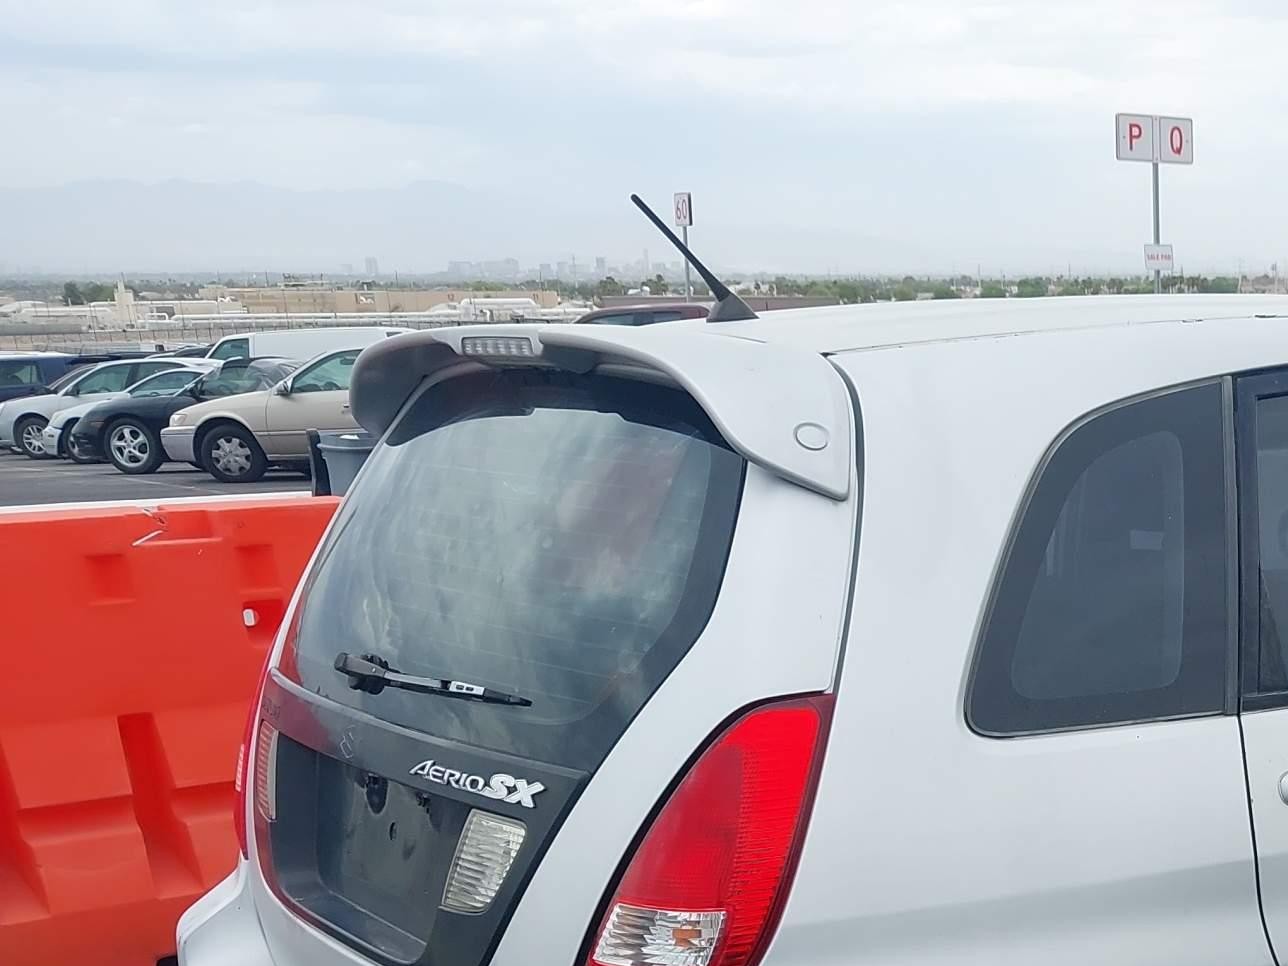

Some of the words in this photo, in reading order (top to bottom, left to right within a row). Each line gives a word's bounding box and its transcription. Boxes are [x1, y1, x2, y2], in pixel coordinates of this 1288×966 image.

[1128, 123, 1143, 152] P
[1170, 126, 1183, 155] Q
[675, 199, 688, 220] 60
[409, 760, 486, 793] AERIO
[481, 773, 546, 809] SX
